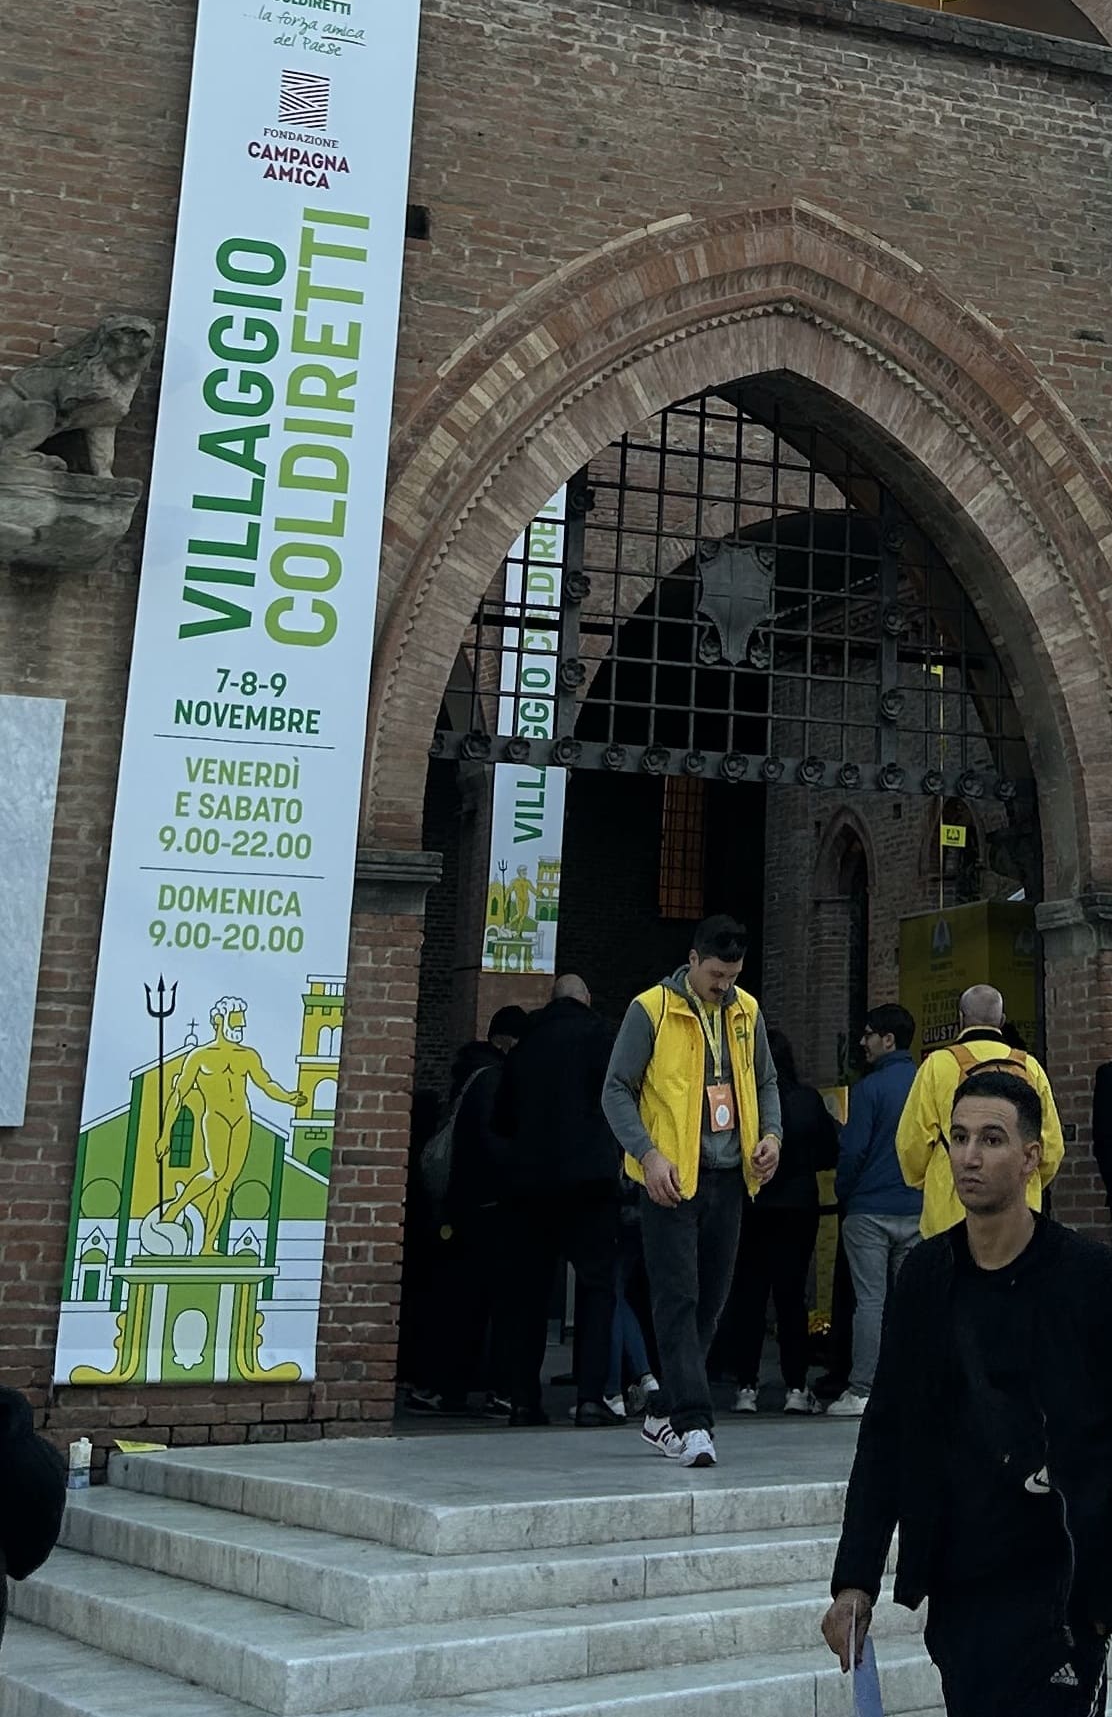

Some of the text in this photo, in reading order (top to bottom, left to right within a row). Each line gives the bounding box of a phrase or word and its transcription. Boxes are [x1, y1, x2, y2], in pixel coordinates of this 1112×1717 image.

[277, 11, 318, 35] forza
[322, 23, 366, 40] amica
[273, 32, 342, 56] del Paese
[264, 127, 340, 148] FONDAZIONE
[248, 141, 351, 173] CAMPAGNA
[263, 163, 330, 190] AMICA
[178, 237, 287, 639] VILLAGGIO
[264, 207, 370, 648] COLDIRETTI
[216, 668, 287, 697] 7-8-9
[174, 699, 321, 734] NOVEMBRE
[186, 756, 300, 789] VENERDÌ
[175, 792, 303, 824] E SABATO
[159, 825, 312, 860] 9.00-22.00
[158, 884, 301, 917] DOMENICA
[148, 920, 304, 953] 9.00-20.00
